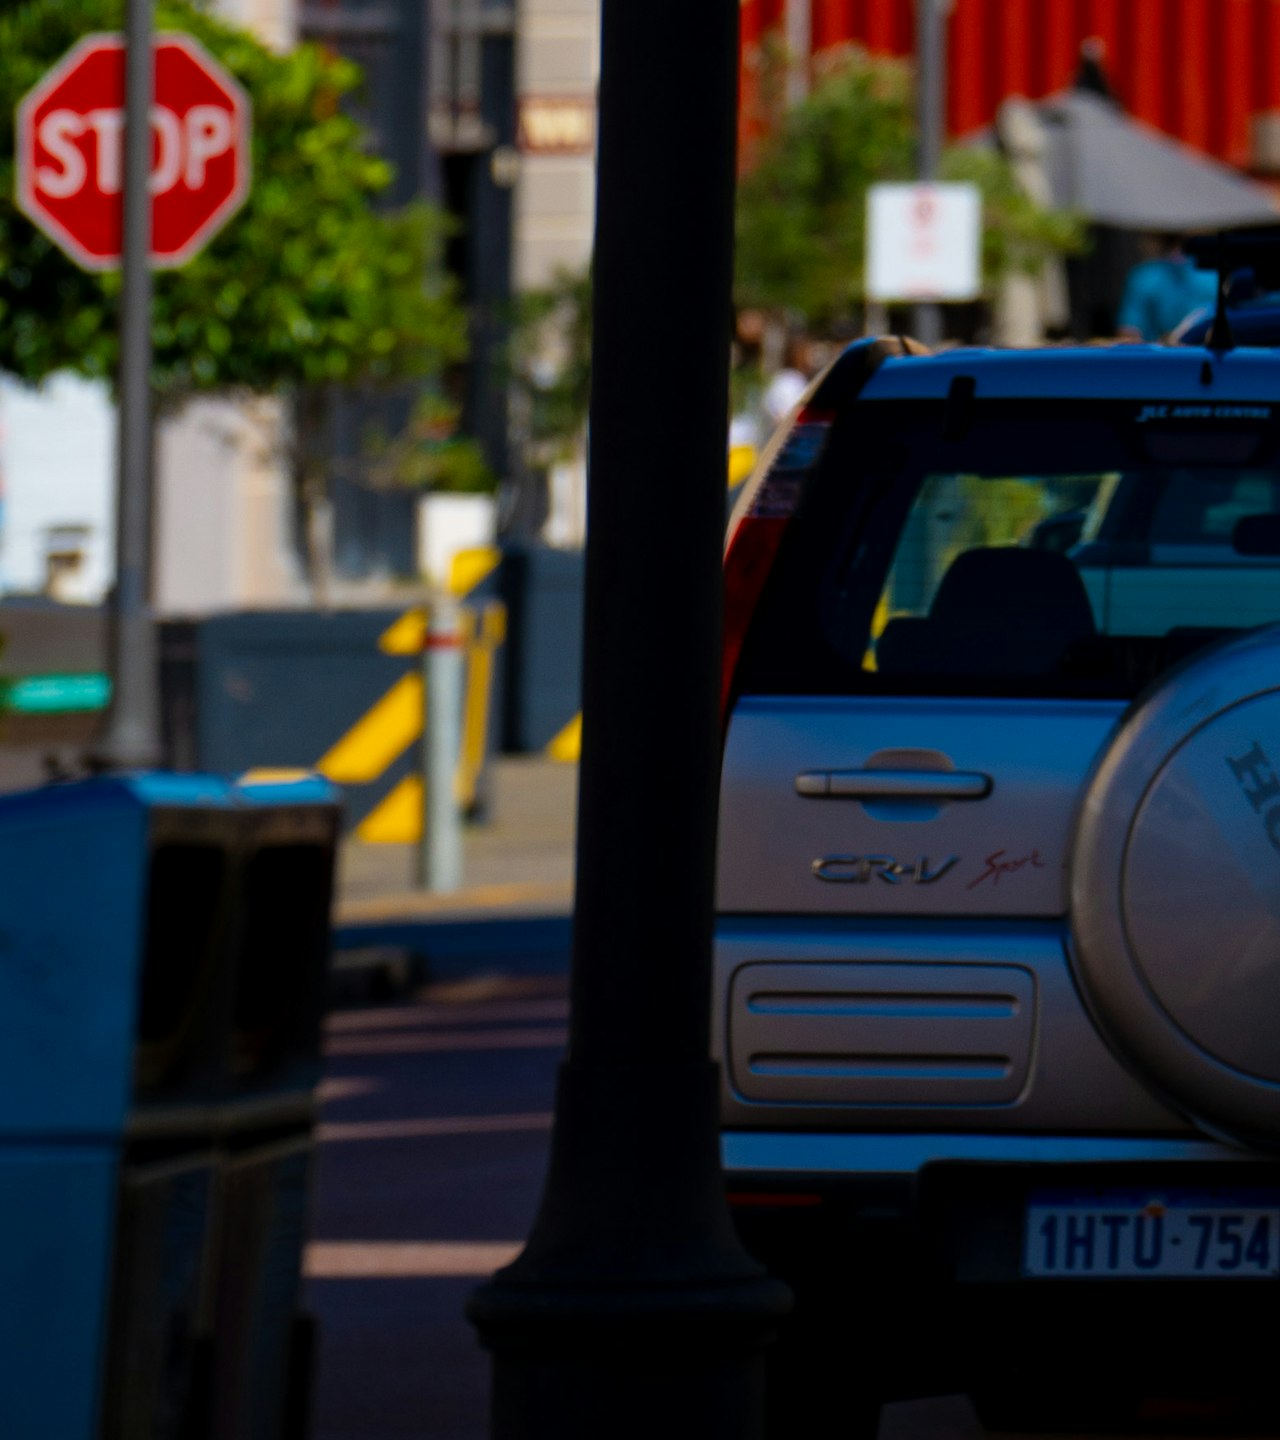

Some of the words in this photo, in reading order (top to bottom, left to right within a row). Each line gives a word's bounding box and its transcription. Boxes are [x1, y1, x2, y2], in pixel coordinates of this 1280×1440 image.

[37, 105, 236, 198] STOP
[810, 853, 960, 884] CR-V
[968, 848, 1045, 890] Sport
